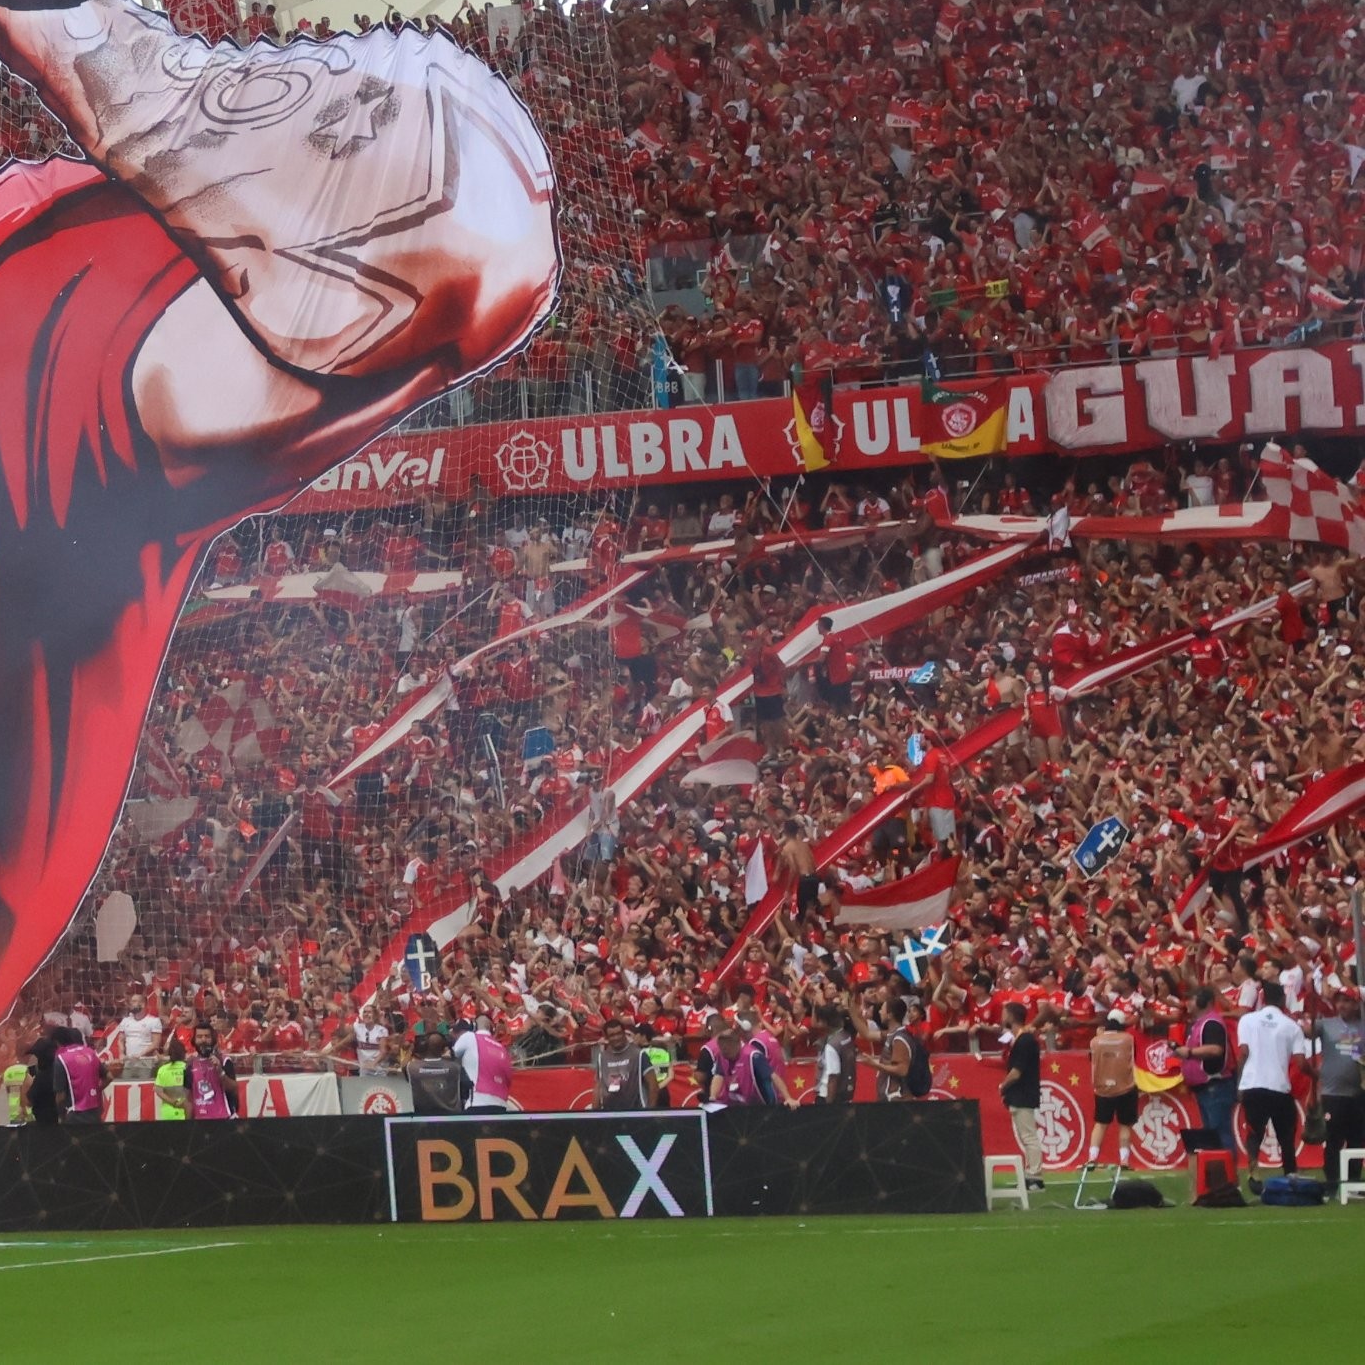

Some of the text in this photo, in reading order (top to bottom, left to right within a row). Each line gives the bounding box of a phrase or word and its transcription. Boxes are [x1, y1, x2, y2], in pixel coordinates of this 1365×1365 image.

[853, 386, 1035, 456] ULA
[1044, 348, 1365, 447] GUA
[562, 414, 747, 481] ULBRA
[417, 1133, 684, 1221] BRAX
